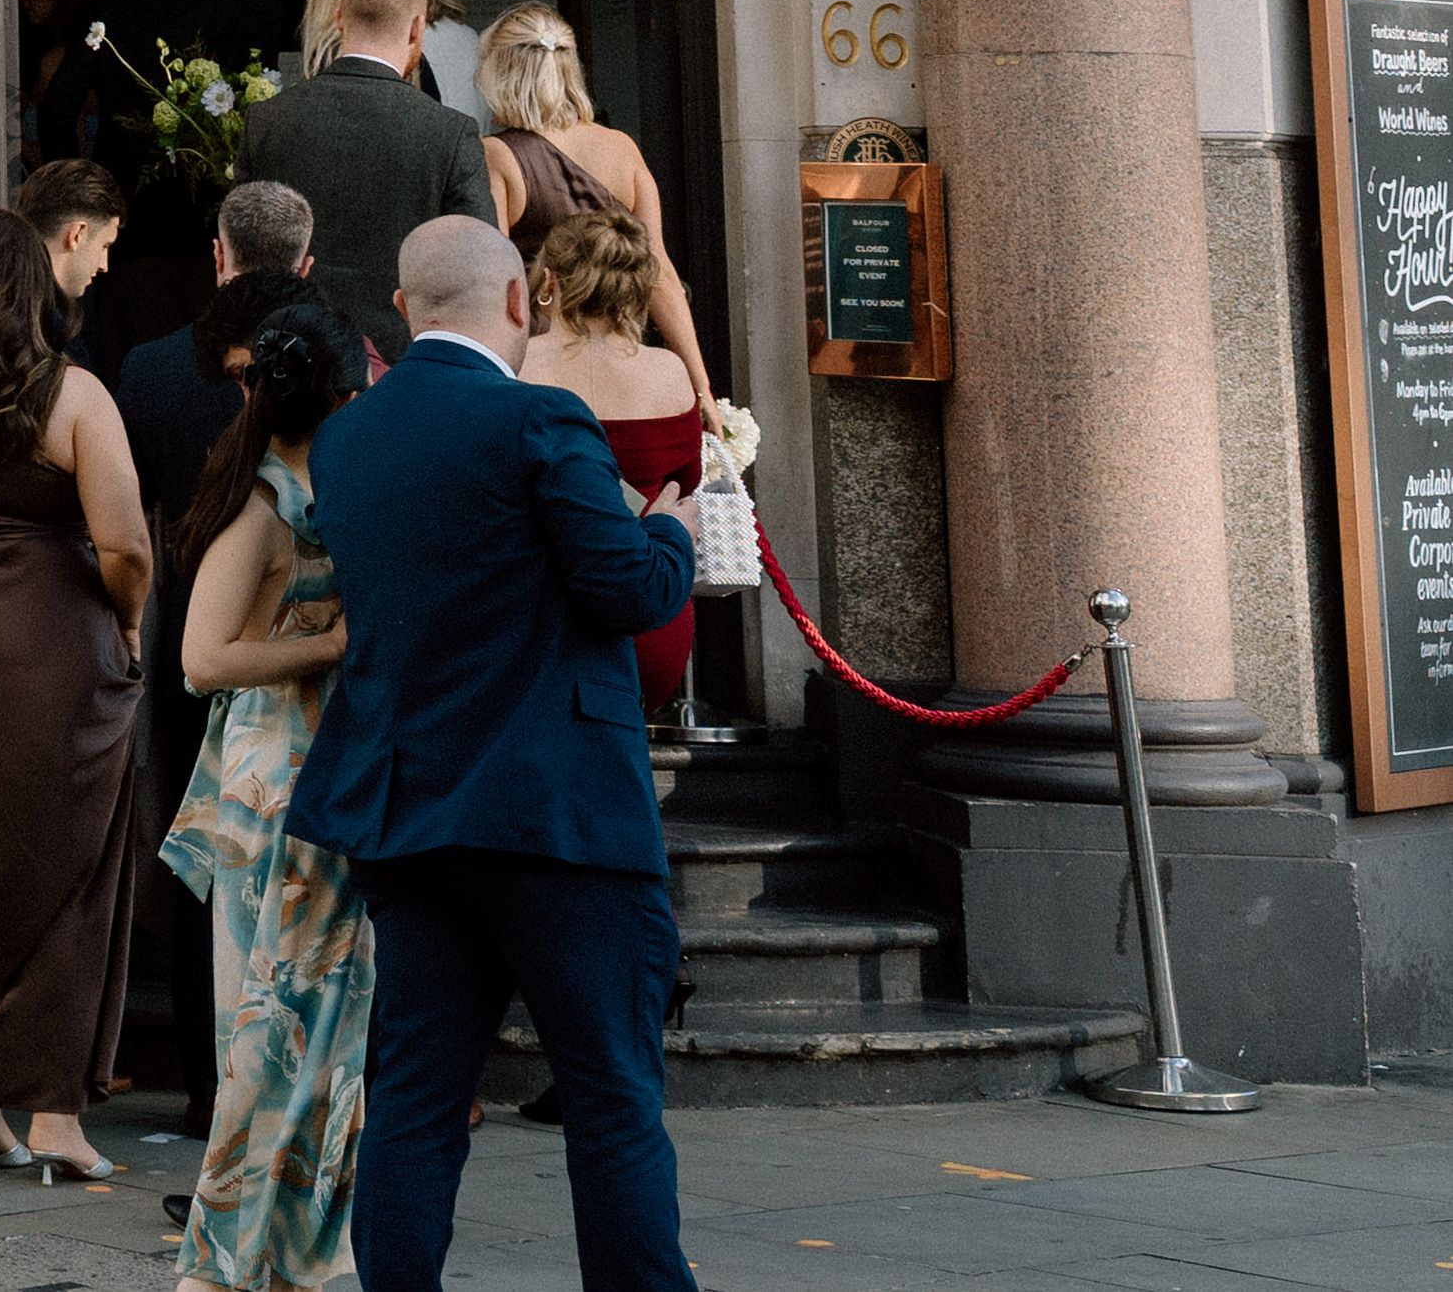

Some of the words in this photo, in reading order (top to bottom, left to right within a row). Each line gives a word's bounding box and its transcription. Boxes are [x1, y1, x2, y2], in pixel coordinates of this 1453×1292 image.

[821, 0, 910, 71] 66
[1371, 23, 1405, 41] Fantastic
[1372, 49, 1417, 77] Draught
[1419, 51, 1449, 72] Beers
[1397, 77, 1424, 94] and
[846, 121, 890, 135] HEATH
[1378, 106, 1413, 131] World
[1416, 108, 1449, 132] Wines
[1377, 176, 1453, 251] Happy
[852, 219, 889, 227] BALFOUR
[855, 245, 889, 253] CLOSED
[843, 258, 862, 266] FOR
[864, 259, 901, 267] PRIVATE
[858, 272, 887, 280] EVENT
[841, 298, 858, 306] SEE
[860, 299, 878, 307] YOU
[1396, 379, 1428, 404] Monday
[1430, 381, 1438, 397] to
[1412, 403, 1429, 426] 4pm
[1430, 404, 1438, 419] to
[1403, 499, 1451, 531] Private
